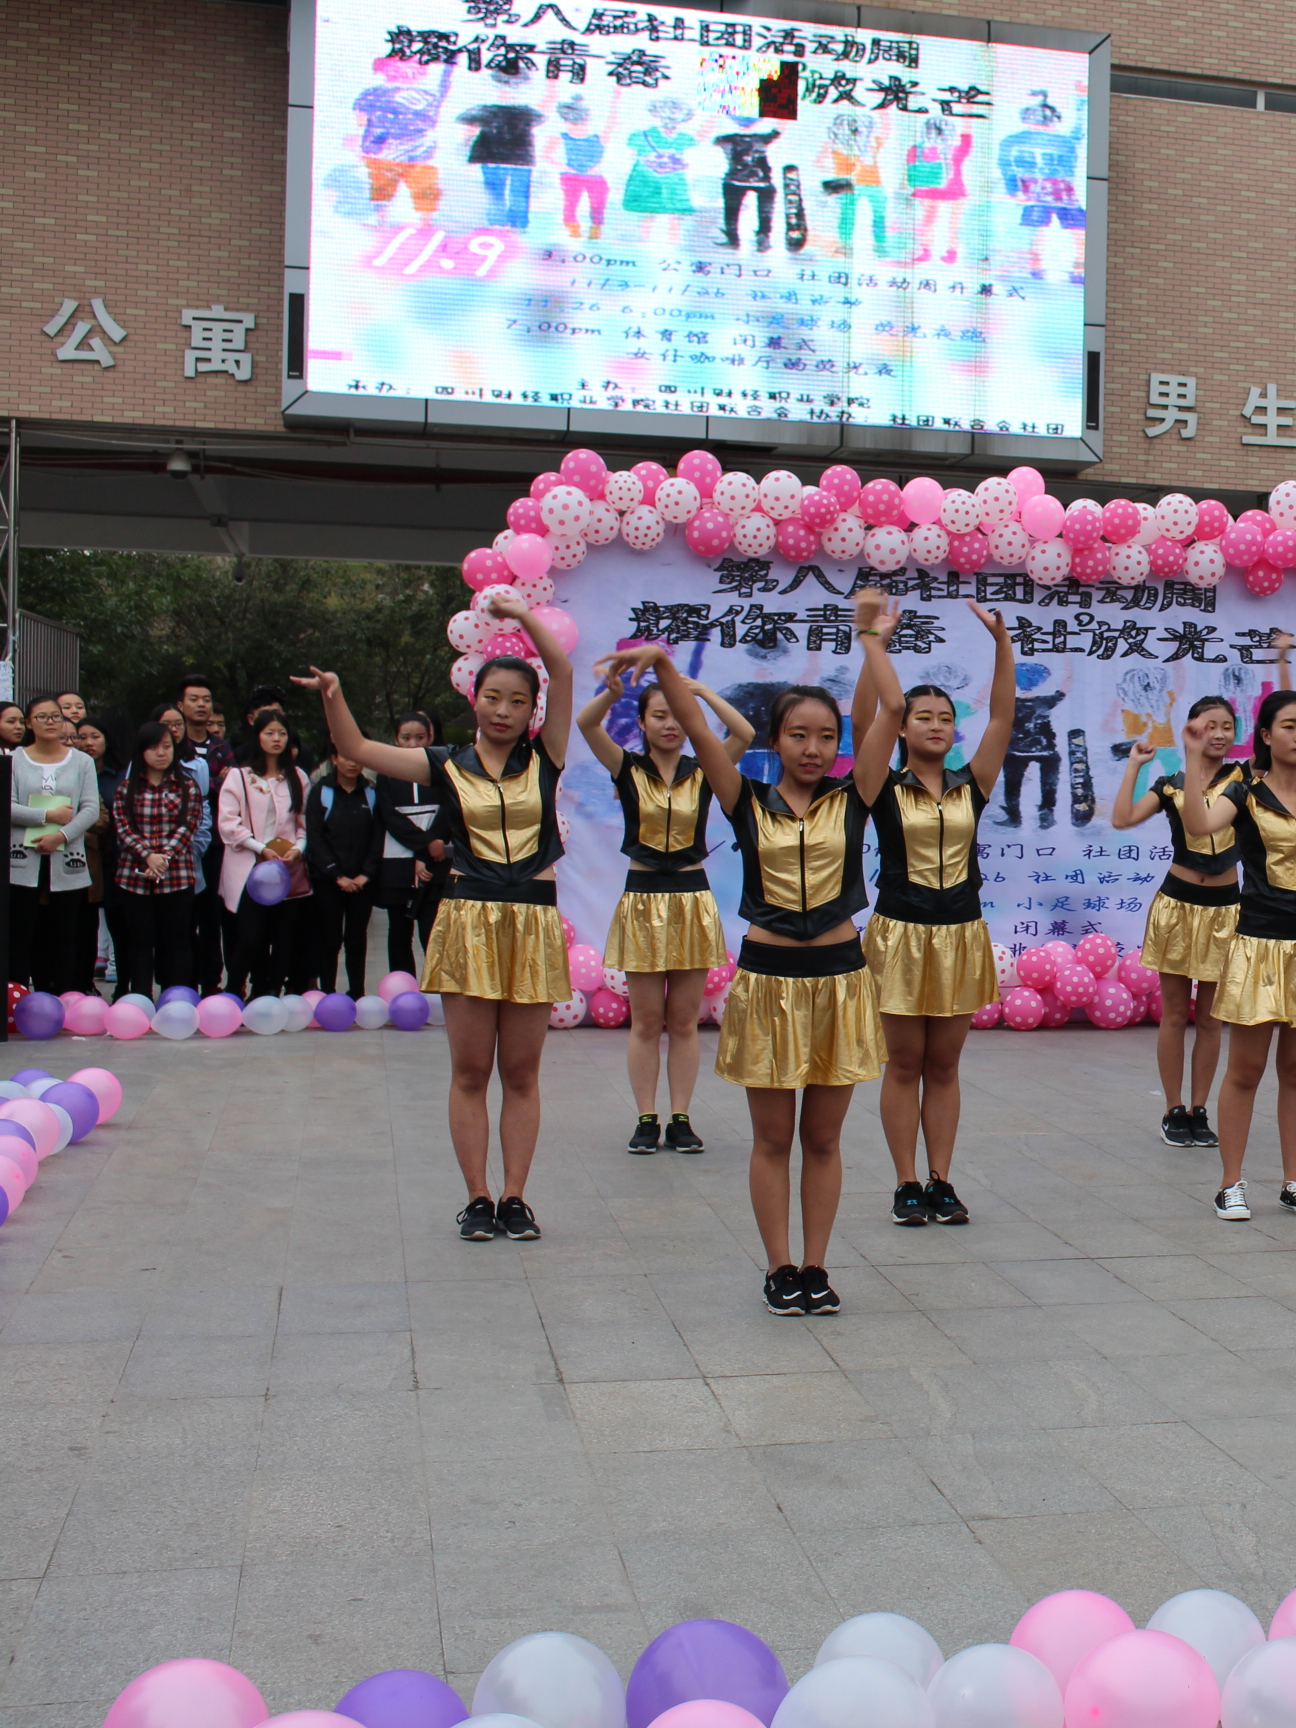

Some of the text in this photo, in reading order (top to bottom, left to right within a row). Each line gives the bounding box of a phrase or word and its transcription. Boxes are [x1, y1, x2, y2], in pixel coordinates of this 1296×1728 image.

[41, 298, 256, 382] 公寓
[711, 557, 1217, 613] 第八届社团活动周
[1027, 869, 1156, 886] 社团活动
[1016, 895, 1144, 913] 小足球场
